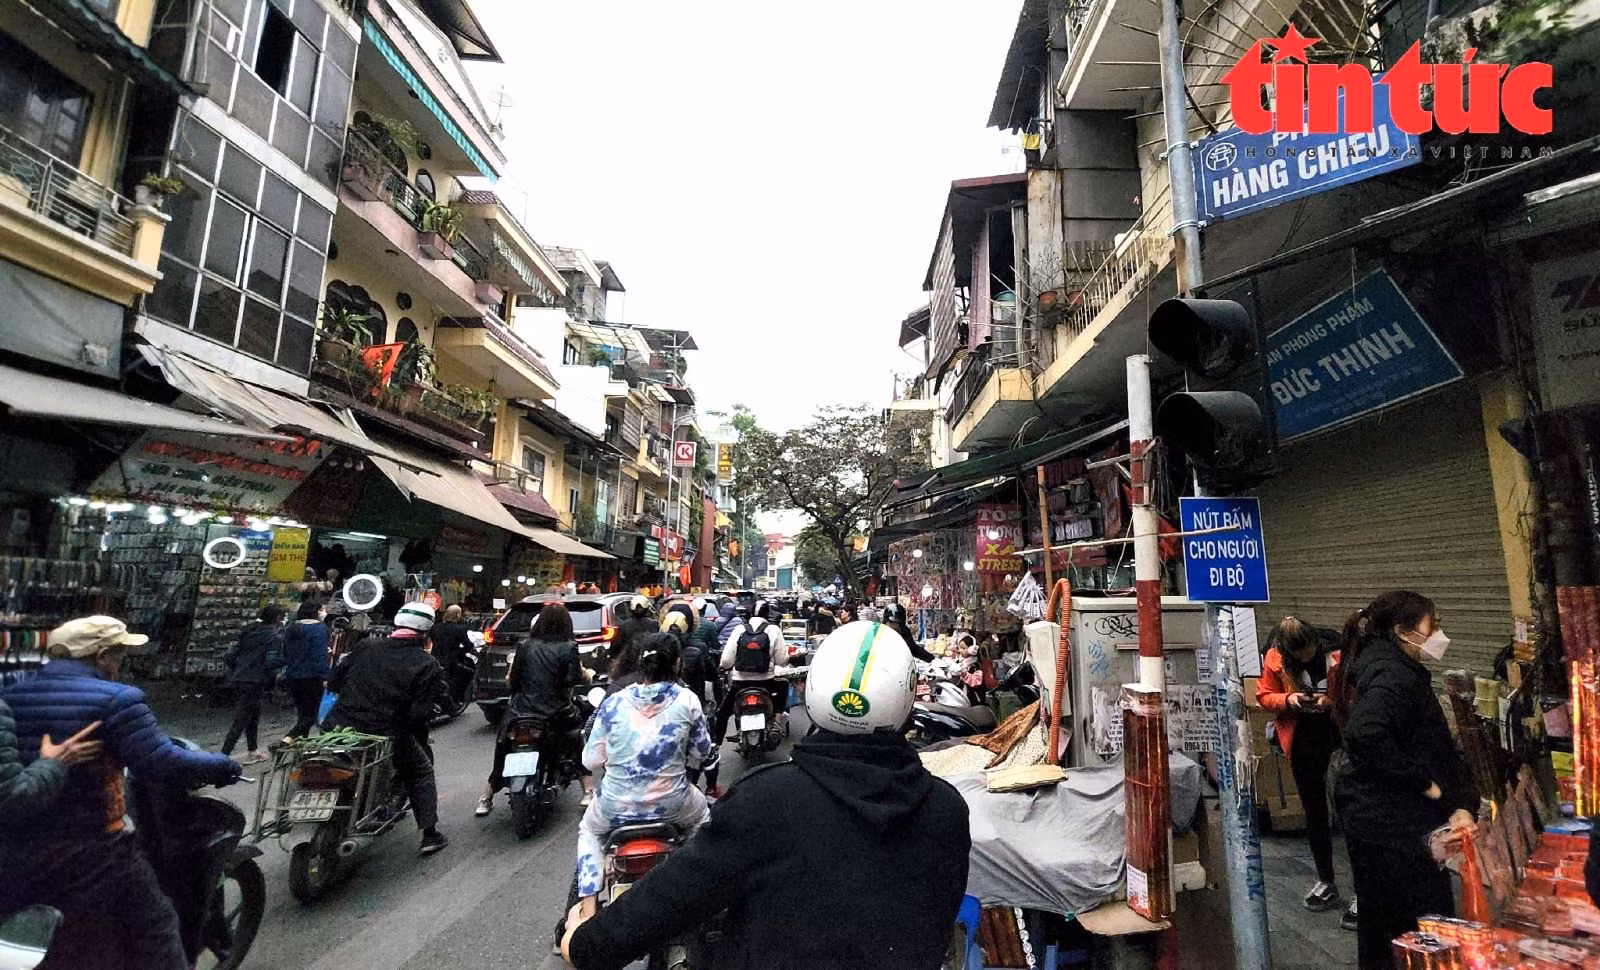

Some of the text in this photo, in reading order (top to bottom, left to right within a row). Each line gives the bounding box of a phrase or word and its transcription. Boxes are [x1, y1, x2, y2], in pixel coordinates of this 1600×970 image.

[1212, 158, 1289, 208] HÀNG
[1317, 321, 1416, 382] THỊNH
[1193, 505, 1252, 530] NÚT BẤM
[1189, 534, 1259, 559] CHO NGƯỜI
[977, 558, 1023, 571] STRESS
[1210, 564, 1245, 592] ĐI BỘ
